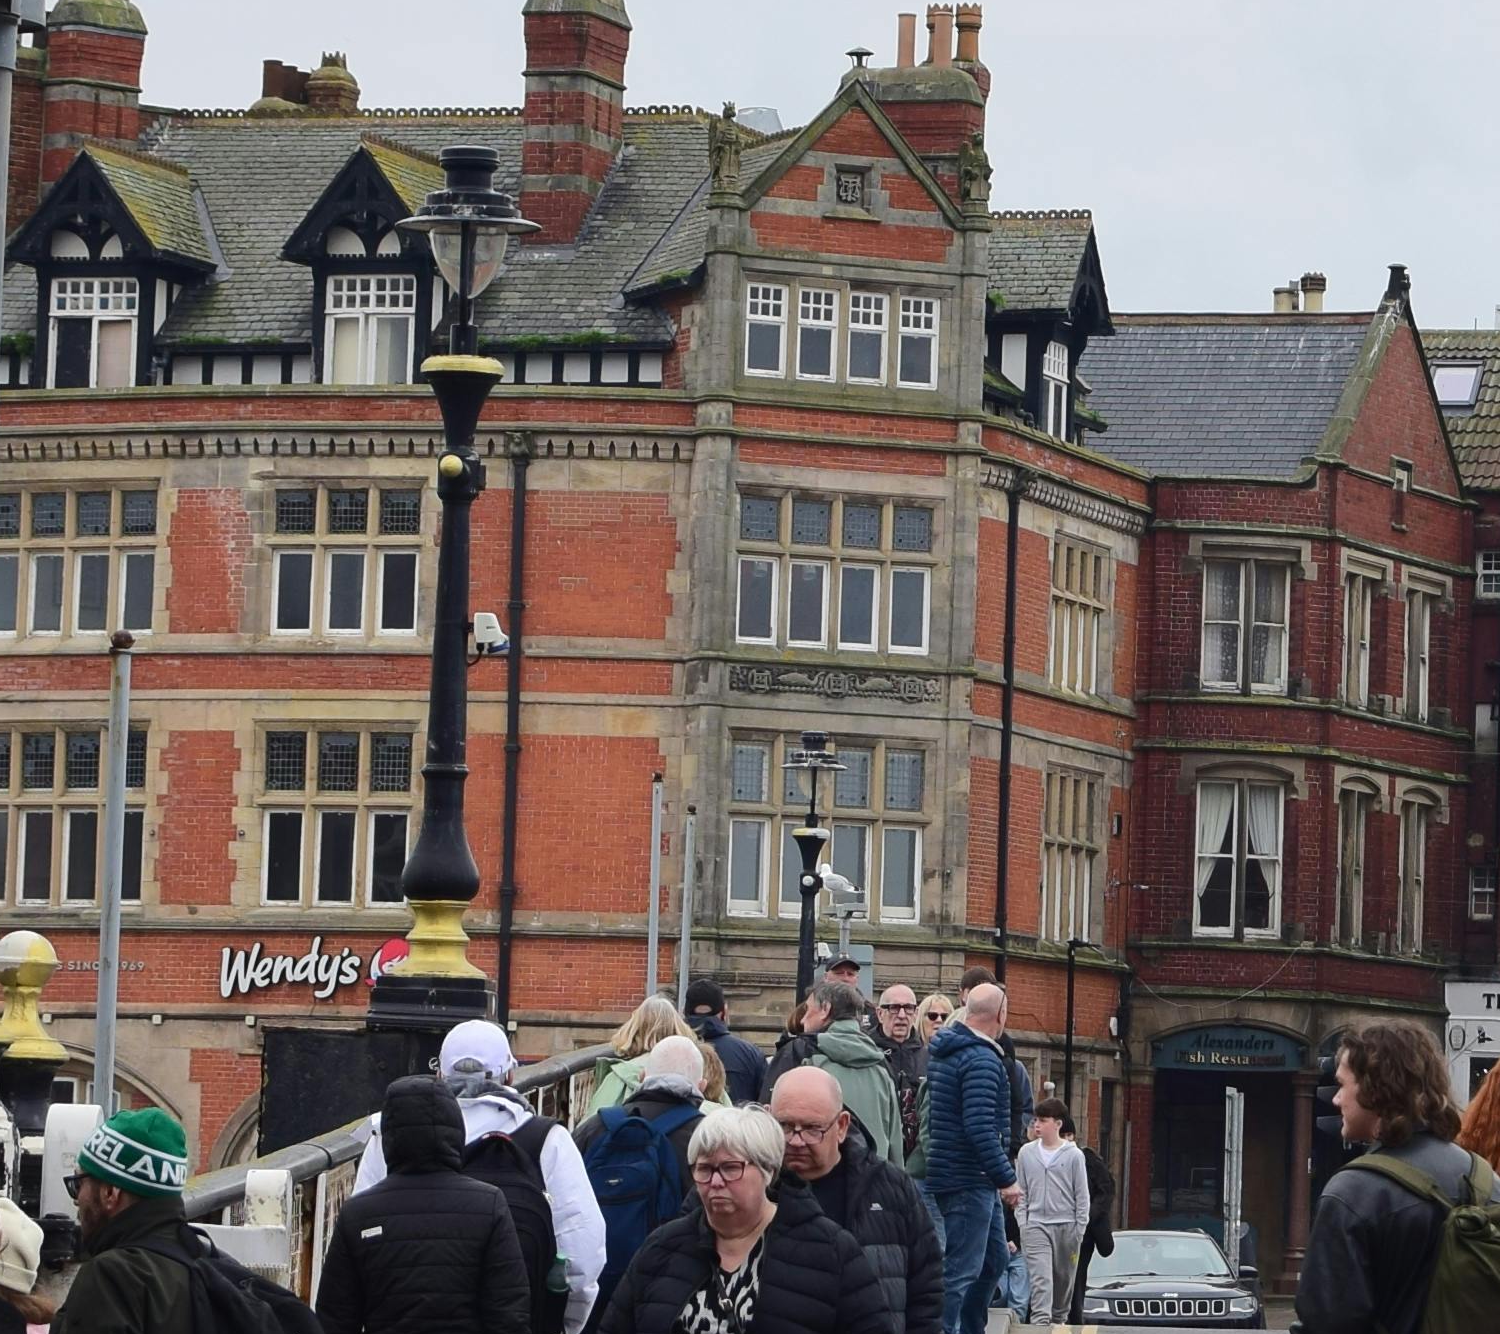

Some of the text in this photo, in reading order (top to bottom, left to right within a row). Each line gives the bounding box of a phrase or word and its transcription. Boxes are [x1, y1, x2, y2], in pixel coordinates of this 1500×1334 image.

[67, 960, 100, 972] SINC
[119, 960, 145, 971] 969
[220, 935, 361, 999] Wendy's
[1191, 1033, 1276, 1050] Alexanders
[84, 1129, 187, 1186] RELAND
